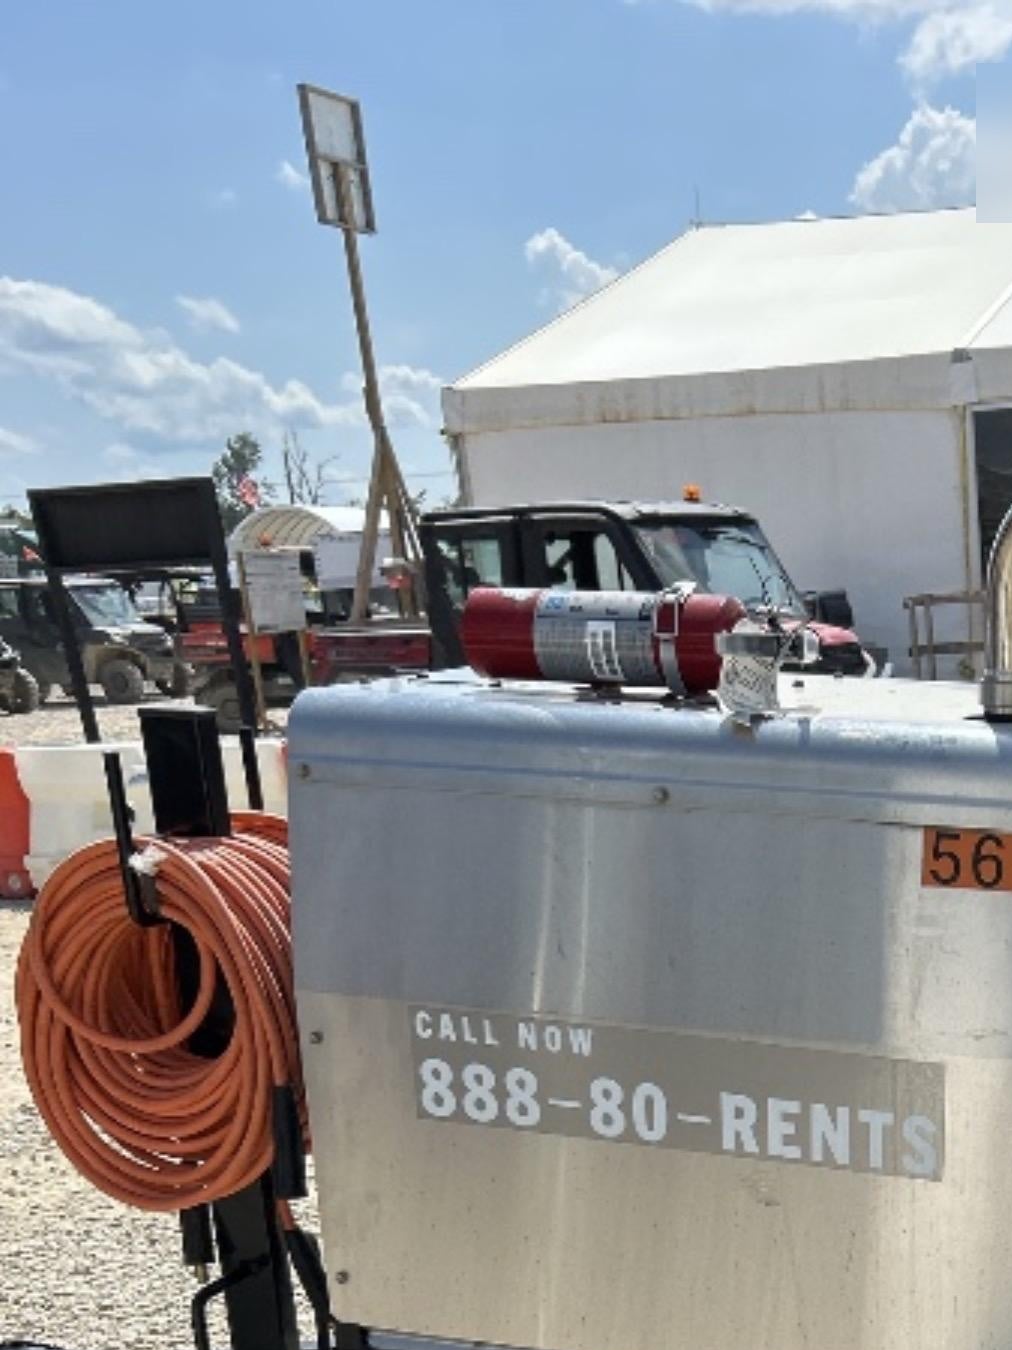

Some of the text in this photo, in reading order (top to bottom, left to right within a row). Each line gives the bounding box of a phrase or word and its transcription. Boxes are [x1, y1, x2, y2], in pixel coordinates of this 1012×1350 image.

[415, 1011, 594, 1057] CALL NOW
[419, 1058, 938, 1175] 888-80-RENTS
